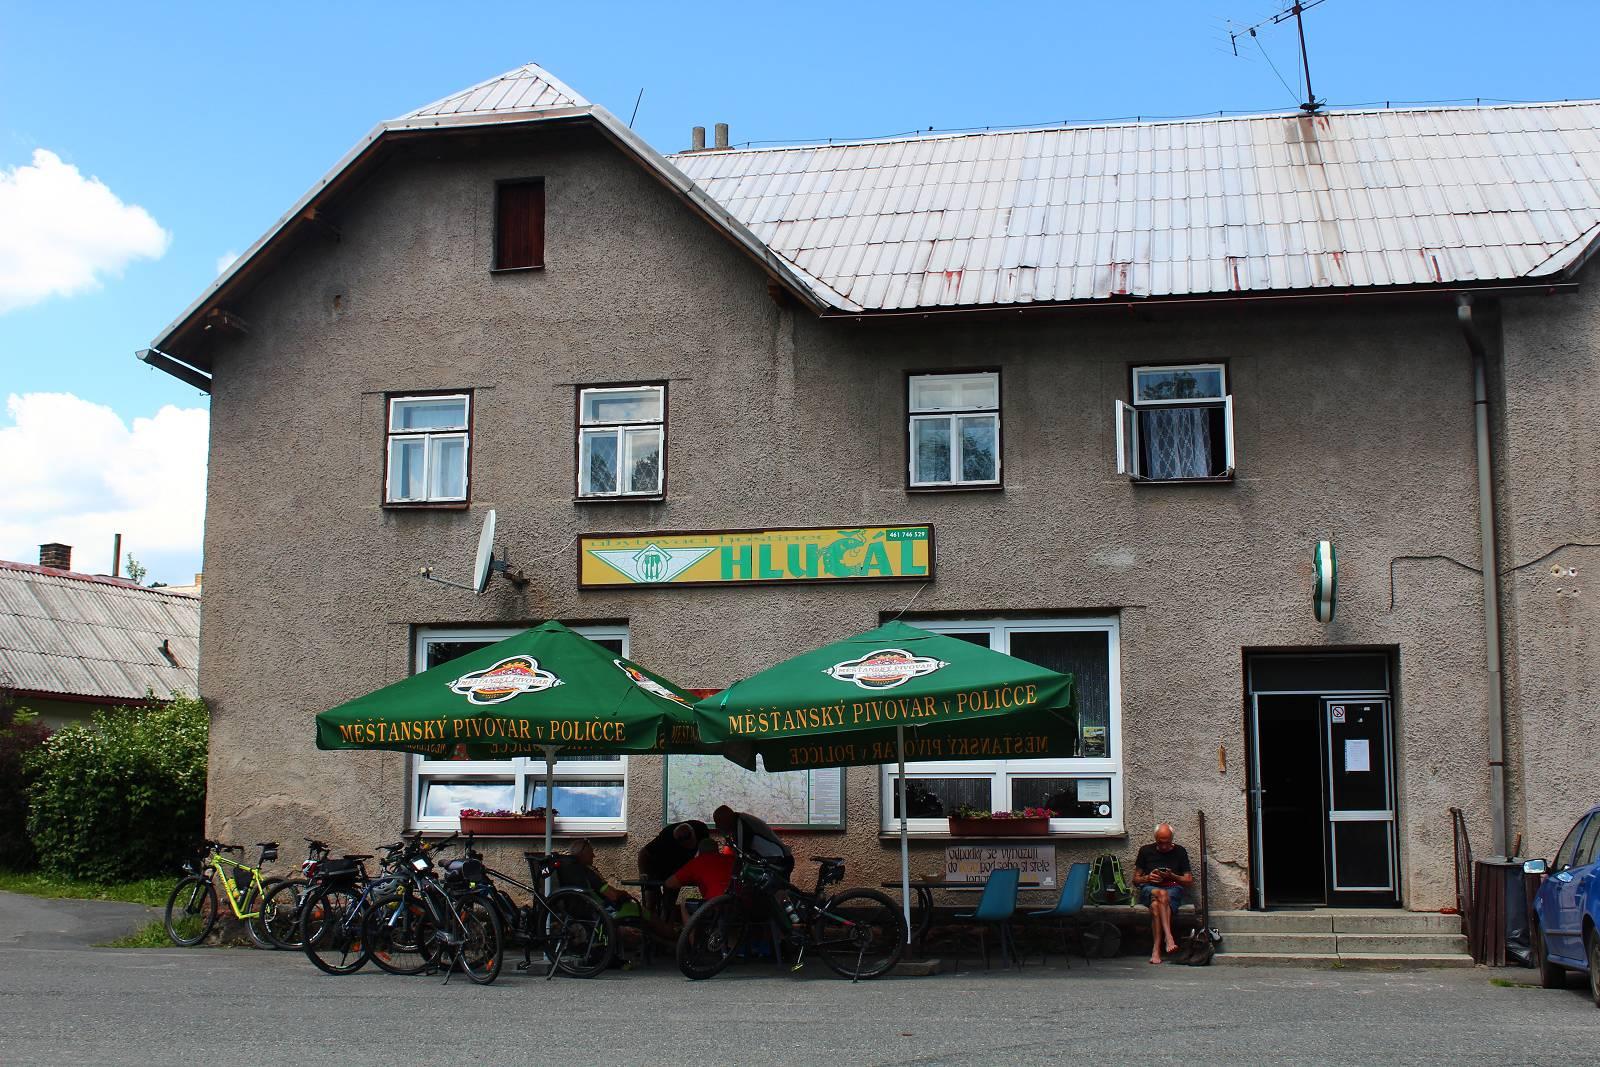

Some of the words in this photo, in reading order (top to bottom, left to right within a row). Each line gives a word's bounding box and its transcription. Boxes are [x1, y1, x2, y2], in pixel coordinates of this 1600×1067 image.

[339, 715, 448, 743] MĚŠŤANSKÝ
[453, 717, 530, 739] PIVOVAR
[550, 716, 626, 742] POLIČCE
[728, 699, 845, 735] MĚŠŤANSKÝ
[853, 696, 937, 724] PIVOVAR
[957, 684, 1038, 714] POLIČCE
